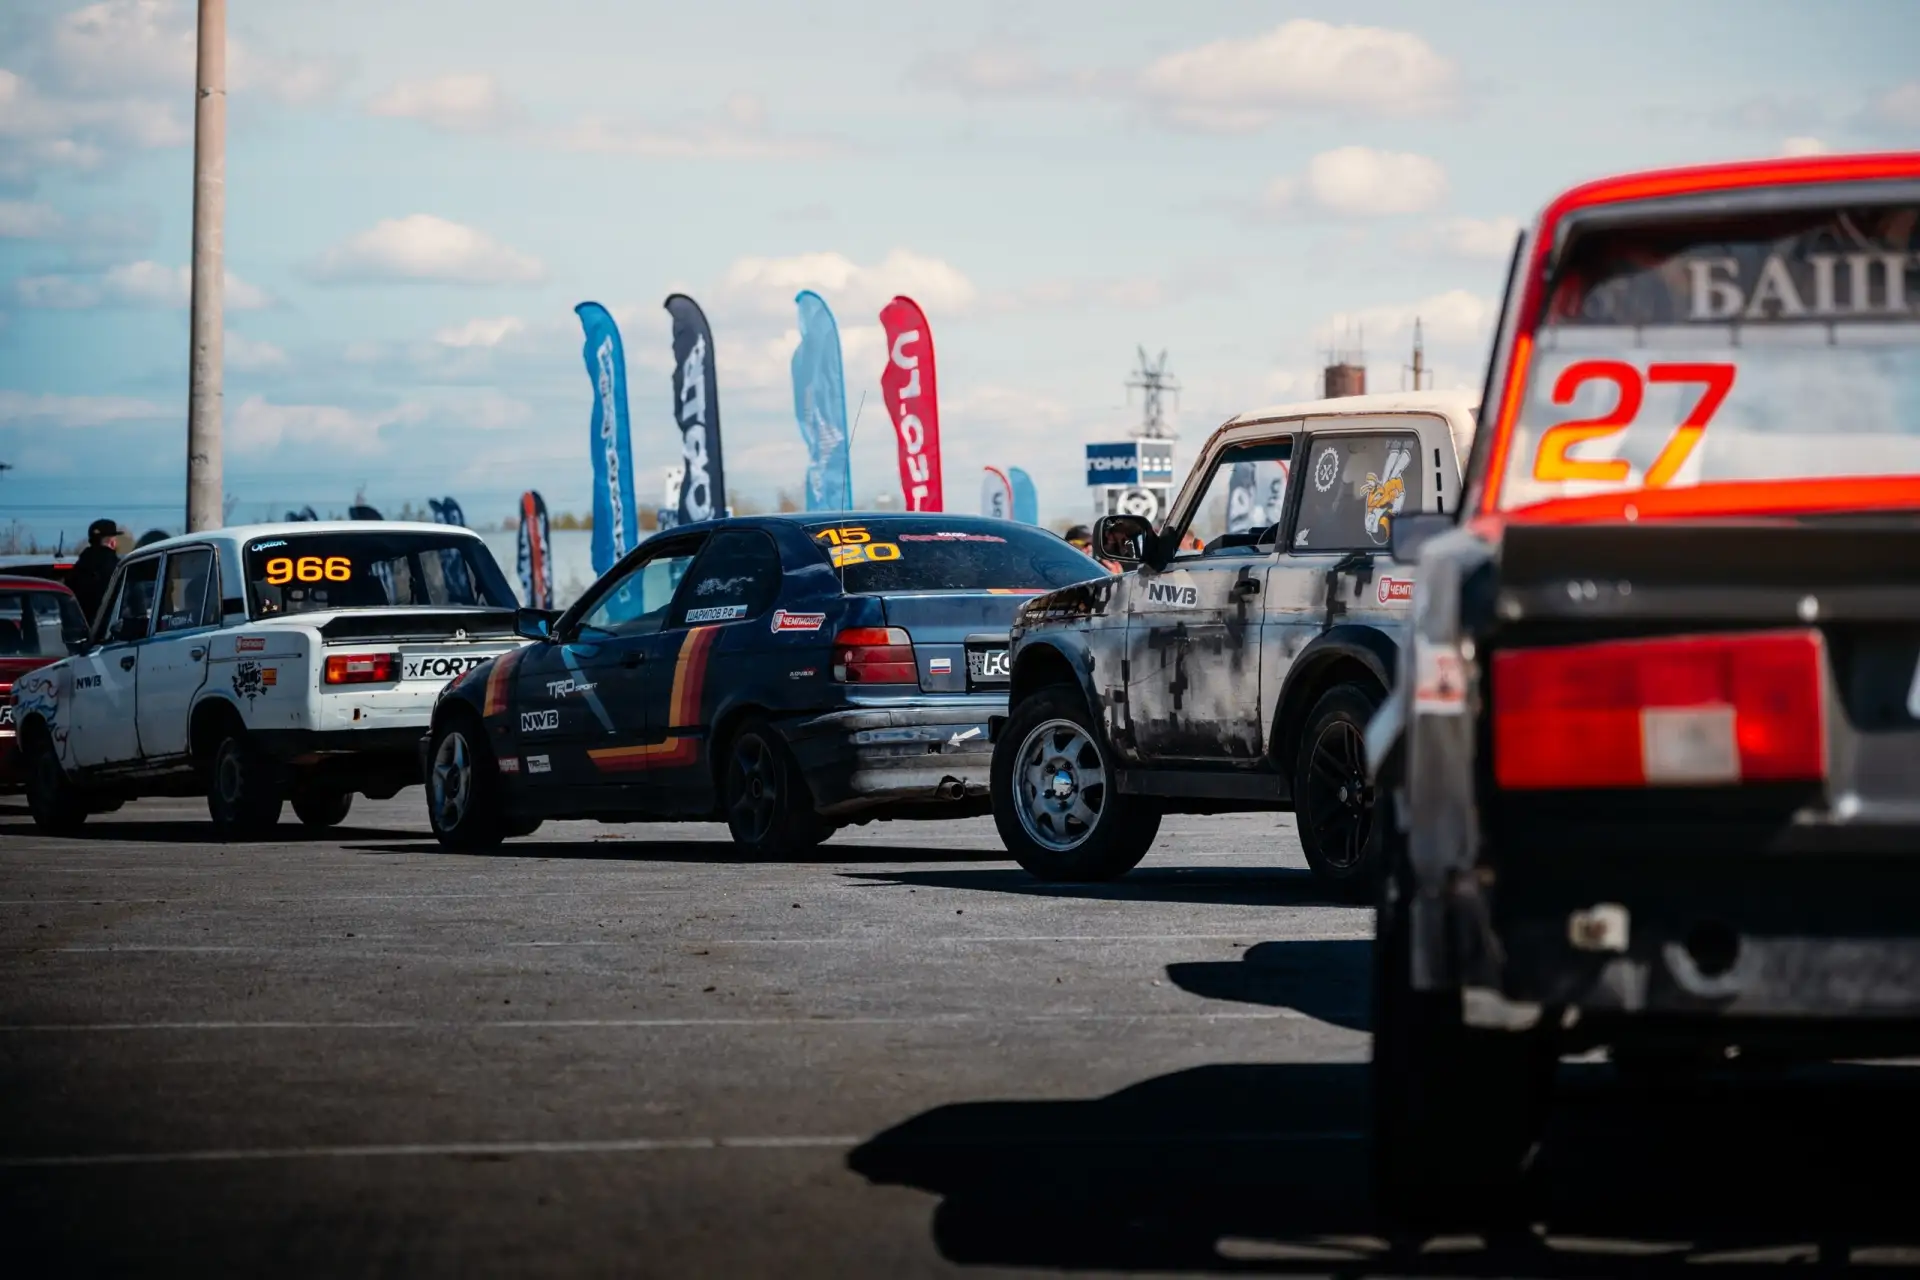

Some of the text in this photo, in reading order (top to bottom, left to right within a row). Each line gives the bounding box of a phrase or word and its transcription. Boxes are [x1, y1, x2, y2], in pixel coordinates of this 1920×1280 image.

[1688, 254, 1920, 319] БАШ
[1533, 360, 1737, 488] 27
[816, 528, 871, 545] 15
[831, 543, 901, 568] 20
[266, 557, 351, 585] 966
[1148, 583, 1197, 605] NWB
[1390, 584, 1413, 596] ЧЕМП
[687, 608, 722, 621] ШАРИПОВ
[420, 656, 490, 677] FORT
[76, 675, 102, 690] NWB
[546, 679, 575, 699] TRD
[521, 710, 559, 731] NWB
